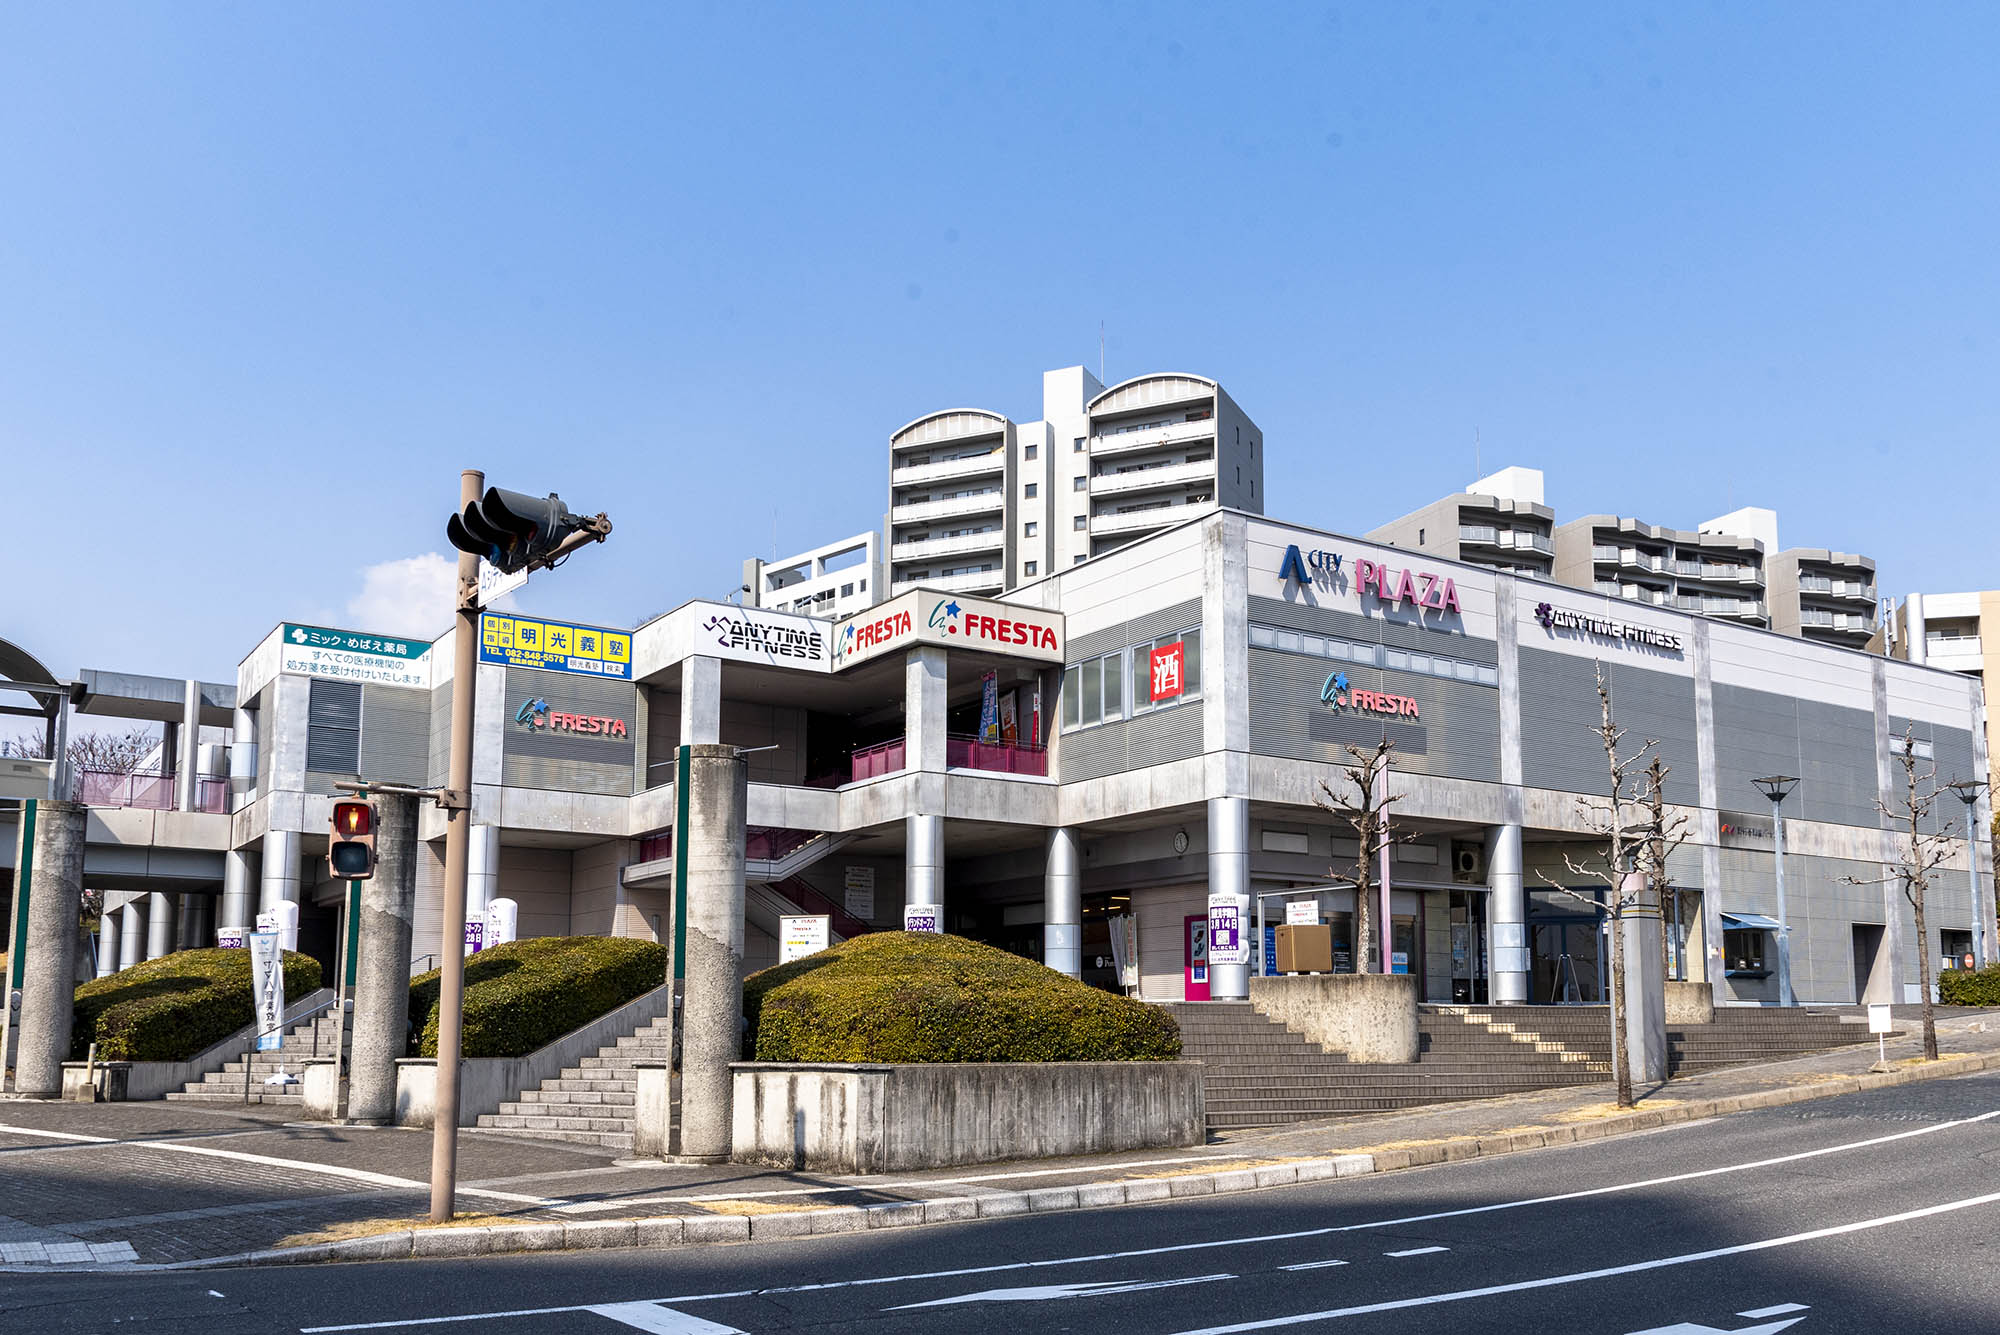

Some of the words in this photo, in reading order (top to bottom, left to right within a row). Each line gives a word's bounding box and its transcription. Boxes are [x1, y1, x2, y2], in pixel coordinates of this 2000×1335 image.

[1308, 550, 1342, 571] CITY
[1356, 559, 1461, 613] PLAZA
[310, 632, 407, 655] ミック・めばえ薬局
[521, 628, 624, 657] 明光義塾
[730, 621, 822, 648] ANYTIME
[856, 610, 912, 651] FRESTA
[965, 613, 1058, 651] FRESTA
[1553, 610, 1622, 637] ANYTIME
[1624, 625, 1684, 650] FITNESS
[312, 650, 405, 670] すべての医療機関の
[484, 646, 503, 656] TEL
[505, 648, 565, 663] 082-848-5578
[731, 637, 821, 660] FITNESS
[1153, 650, 1180, 695] 酒
[1351, 688, 1419, 717] FRESTA
[550, 712, 626, 736] FRESTA
[1211, 918, 1237, 930] 3月14日
